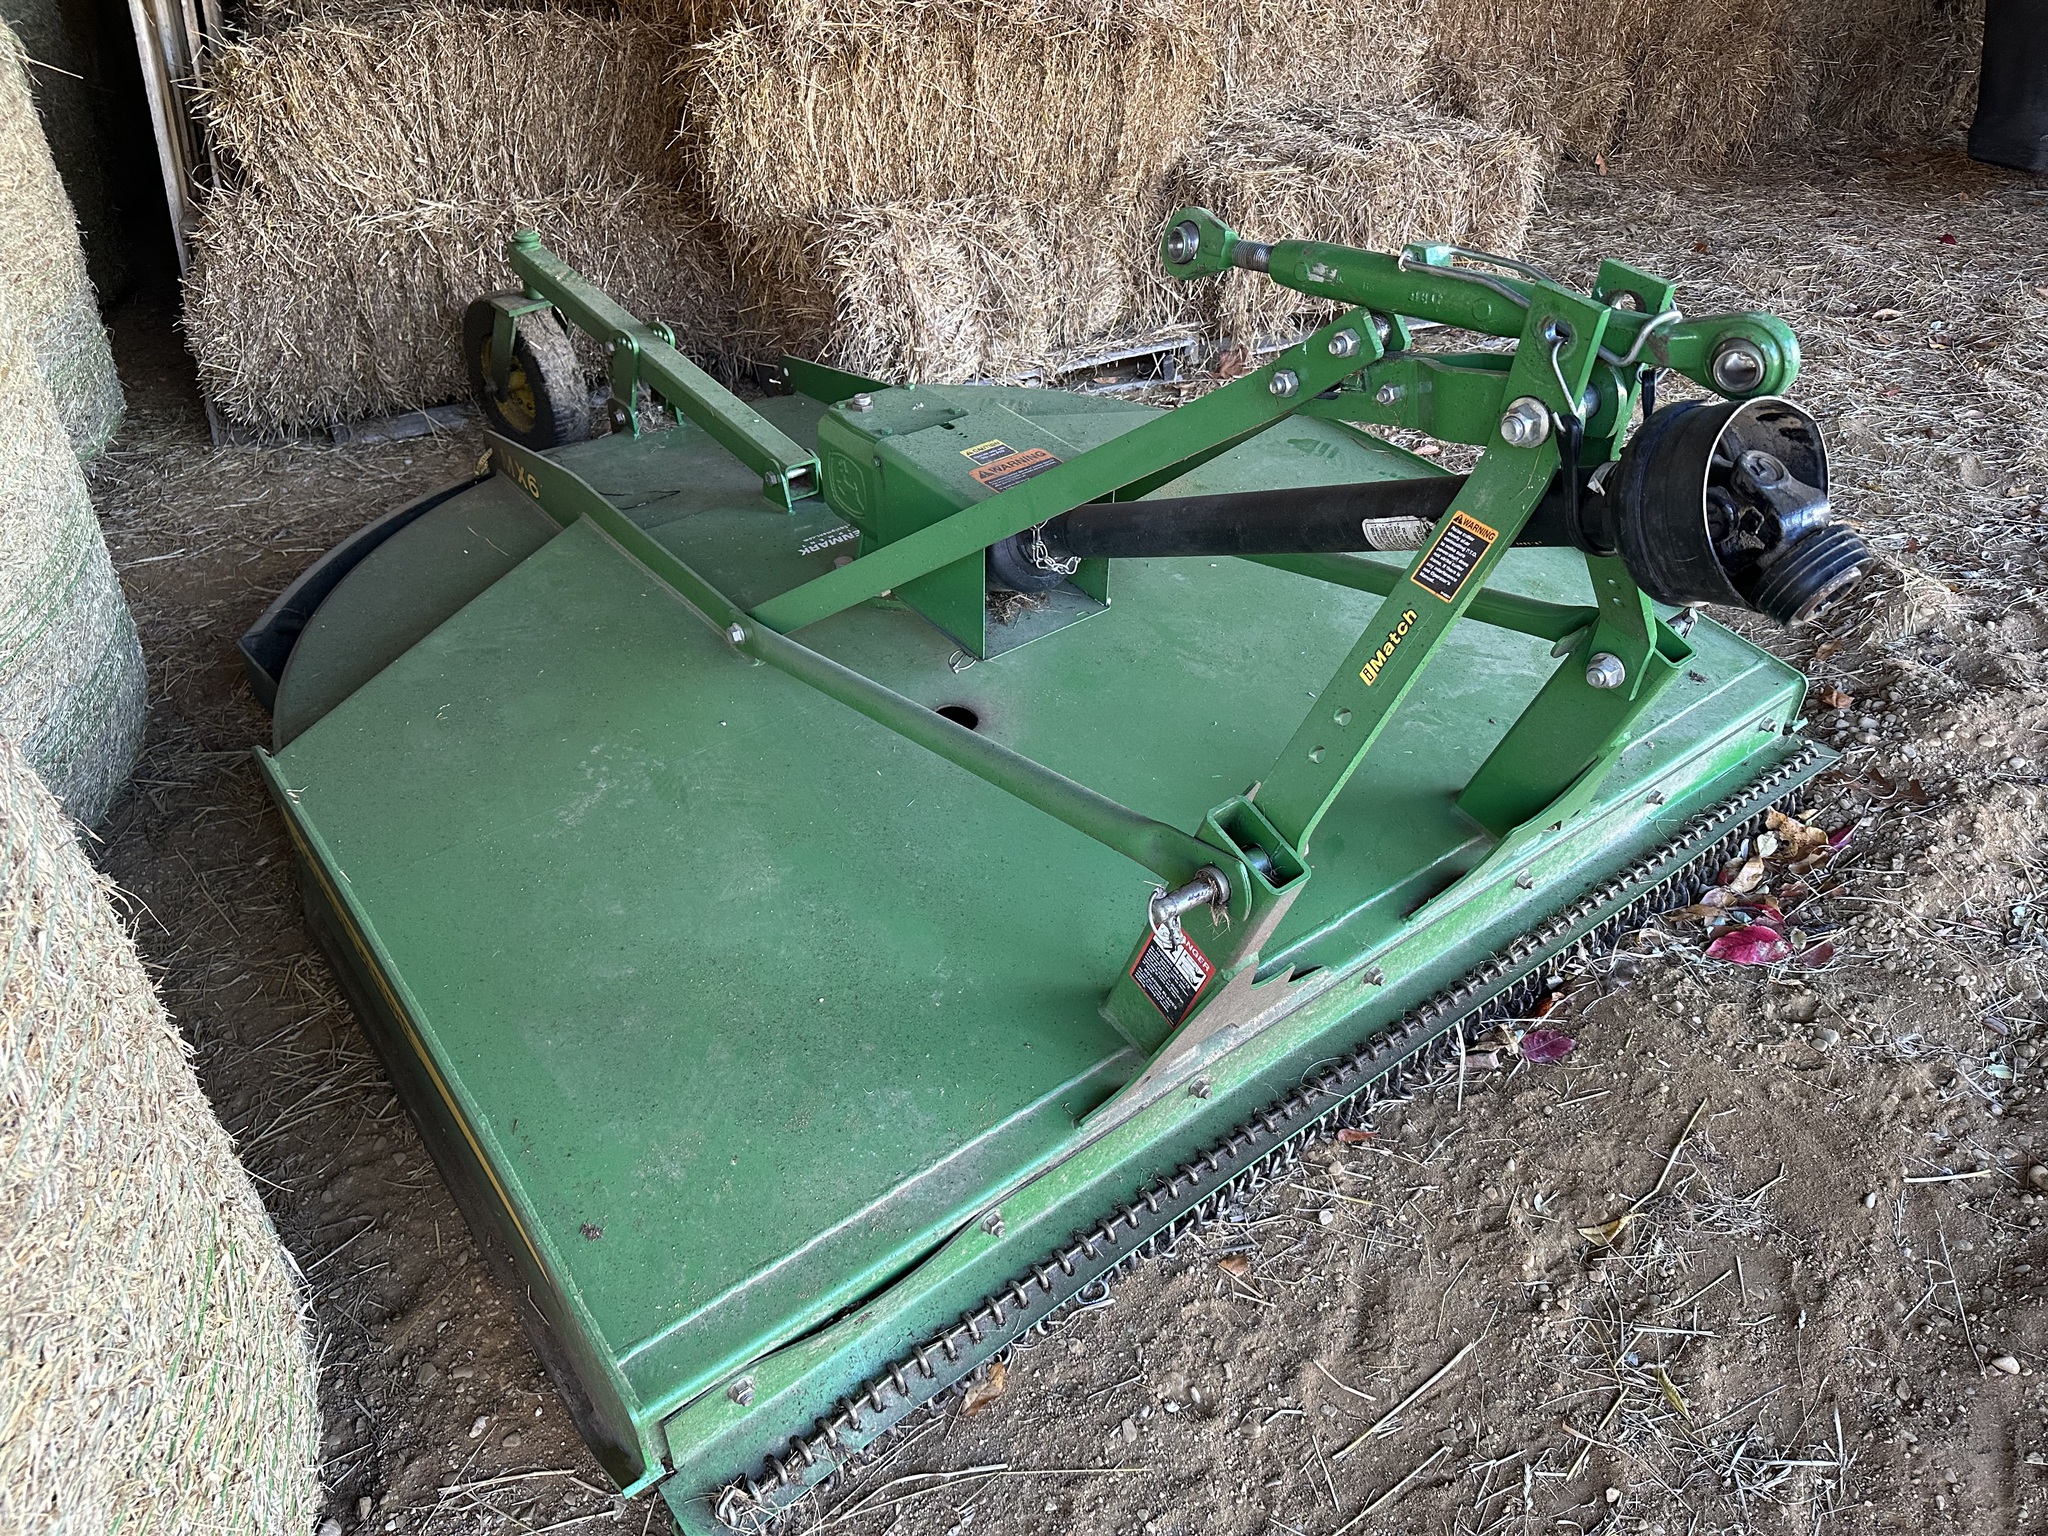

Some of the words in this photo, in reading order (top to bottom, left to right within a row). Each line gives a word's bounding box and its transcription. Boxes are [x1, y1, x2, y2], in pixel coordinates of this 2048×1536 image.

[988, 451, 1047, 474] WARNING
[1461, 517, 1496, 541] WARNING
[798, 529, 860, 556] ENMARK
[1359, 608, 1419, 687] iMatch
